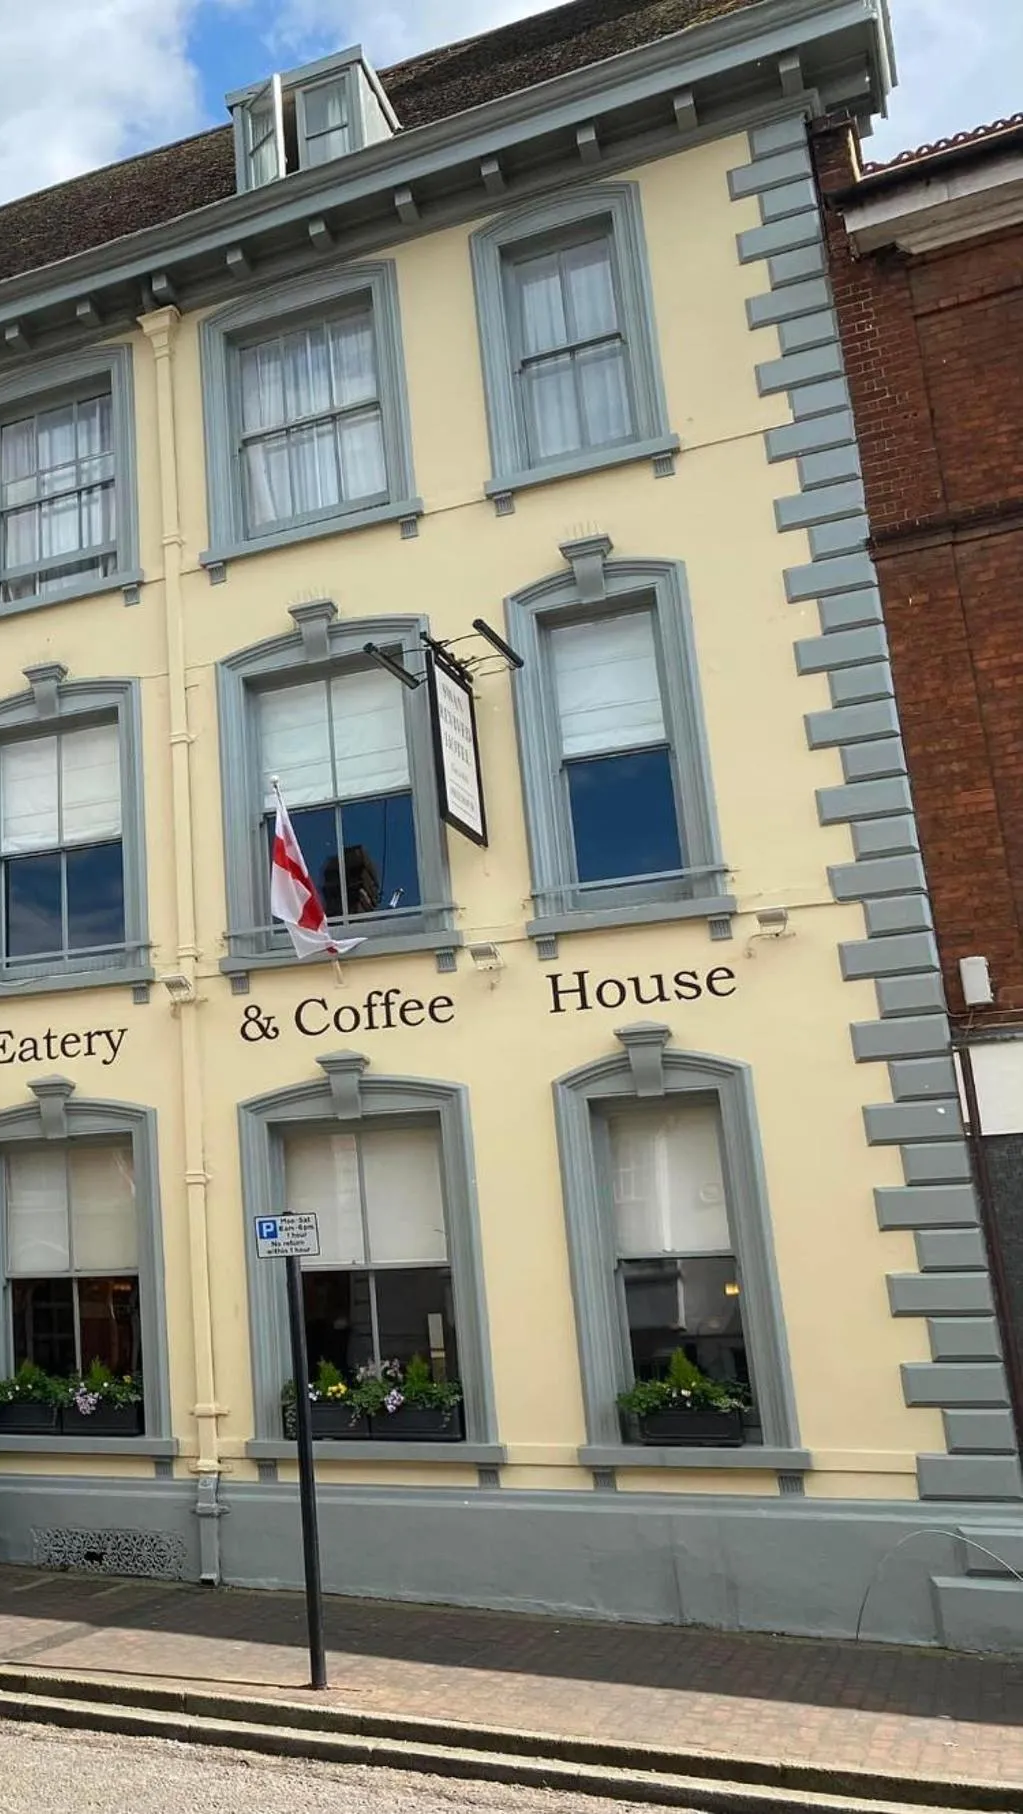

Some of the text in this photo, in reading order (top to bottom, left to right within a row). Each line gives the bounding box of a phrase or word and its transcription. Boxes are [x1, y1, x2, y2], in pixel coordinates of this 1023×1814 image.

[240, 1004, 280, 1042] &
[294, 988, 454, 1036] Coffee
[546, 966, 737, 1014] House
[262, 1222, 275, 1238] P
